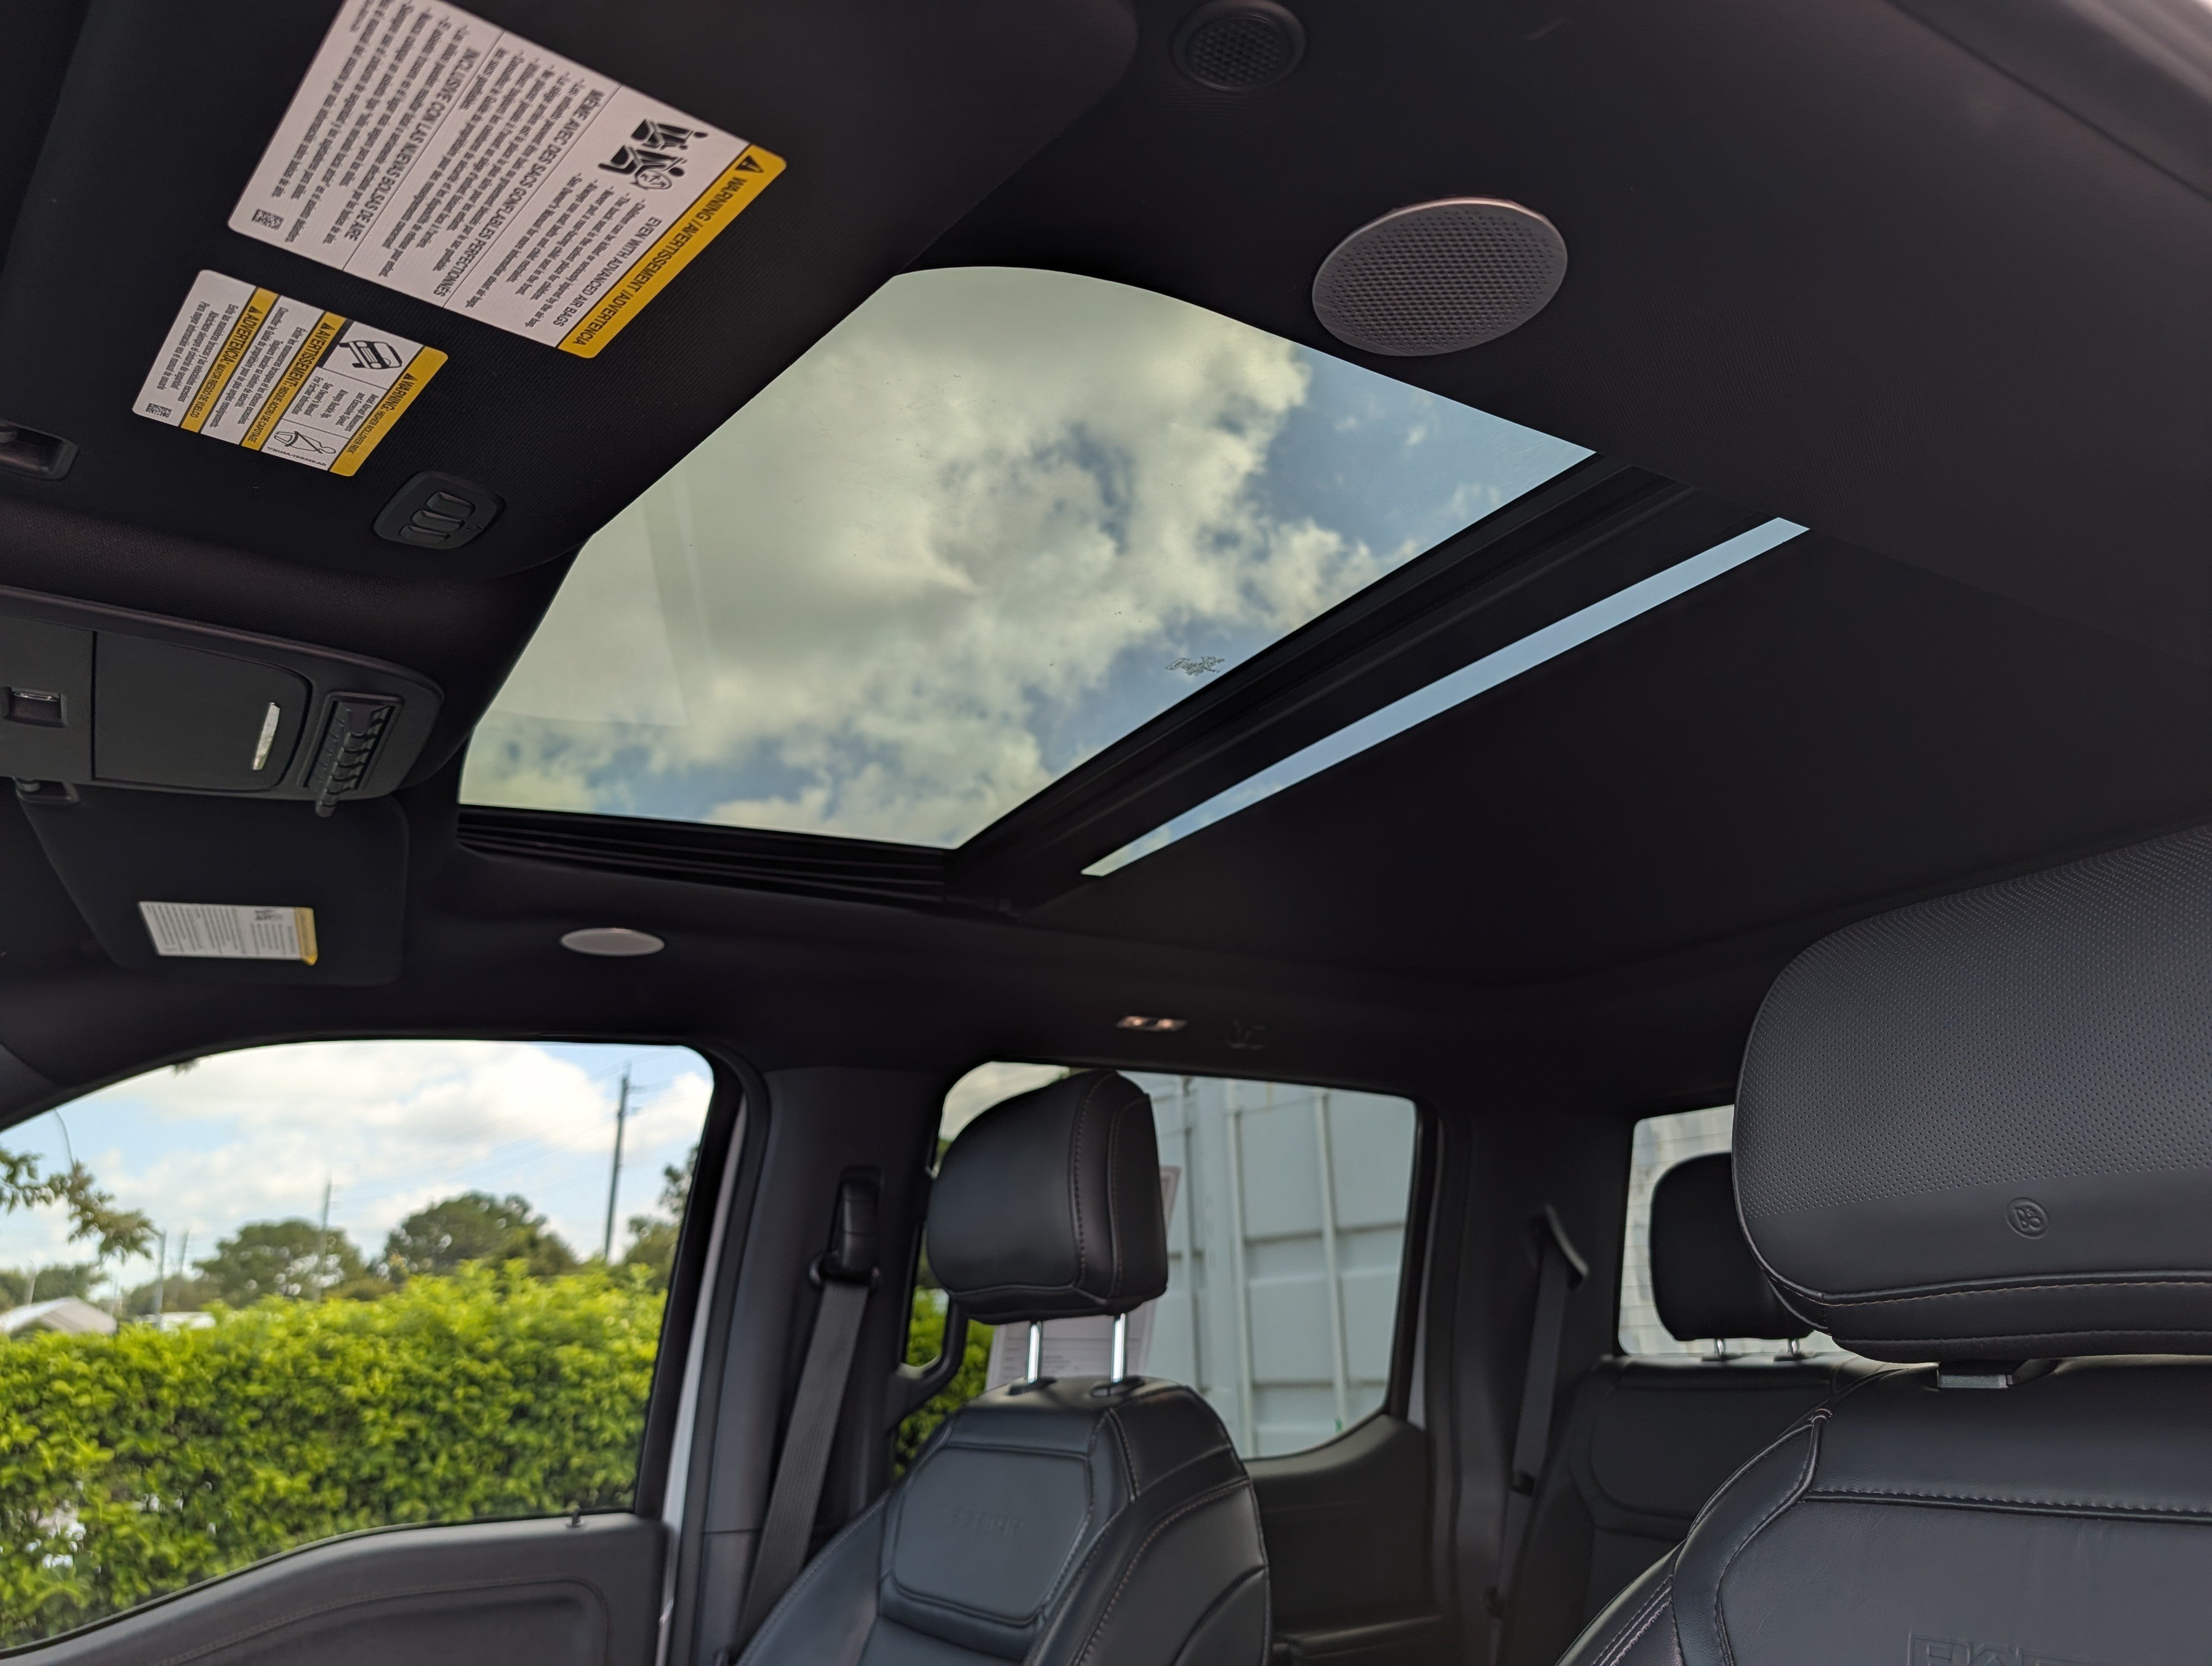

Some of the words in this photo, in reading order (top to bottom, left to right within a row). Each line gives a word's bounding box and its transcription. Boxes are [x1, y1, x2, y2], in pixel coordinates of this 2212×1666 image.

[695, 176, 747, 221] WARNING
[634, 216, 663, 240] EVEN
[616, 238, 642, 259] WITH
[581, 257, 623, 296] ADVANCED
[569, 293, 589, 308] AIR
[552, 306, 577, 327] BAGS
[220, 313, 260, 365] ADVERTENCIA:
[283, 329, 331, 387] AVERTISSEMENT:
[210, 363, 227, 380] MAYOR
[202, 378, 218, 395] RIESGO
[272, 385, 290, 402] RISQUE
[380, 380, 415, 412] WARNING:
[198, 394, 209, 402] DE
[263, 400, 280, 416] ACCRU
[189, 400, 206, 418] VUELCO
[368, 409, 386, 426] HIGHER
[247, 420, 267, 443] CAPOTAGE
[352, 424, 375, 445] ROLLOVER
[345, 444, 359, 454] RISK
